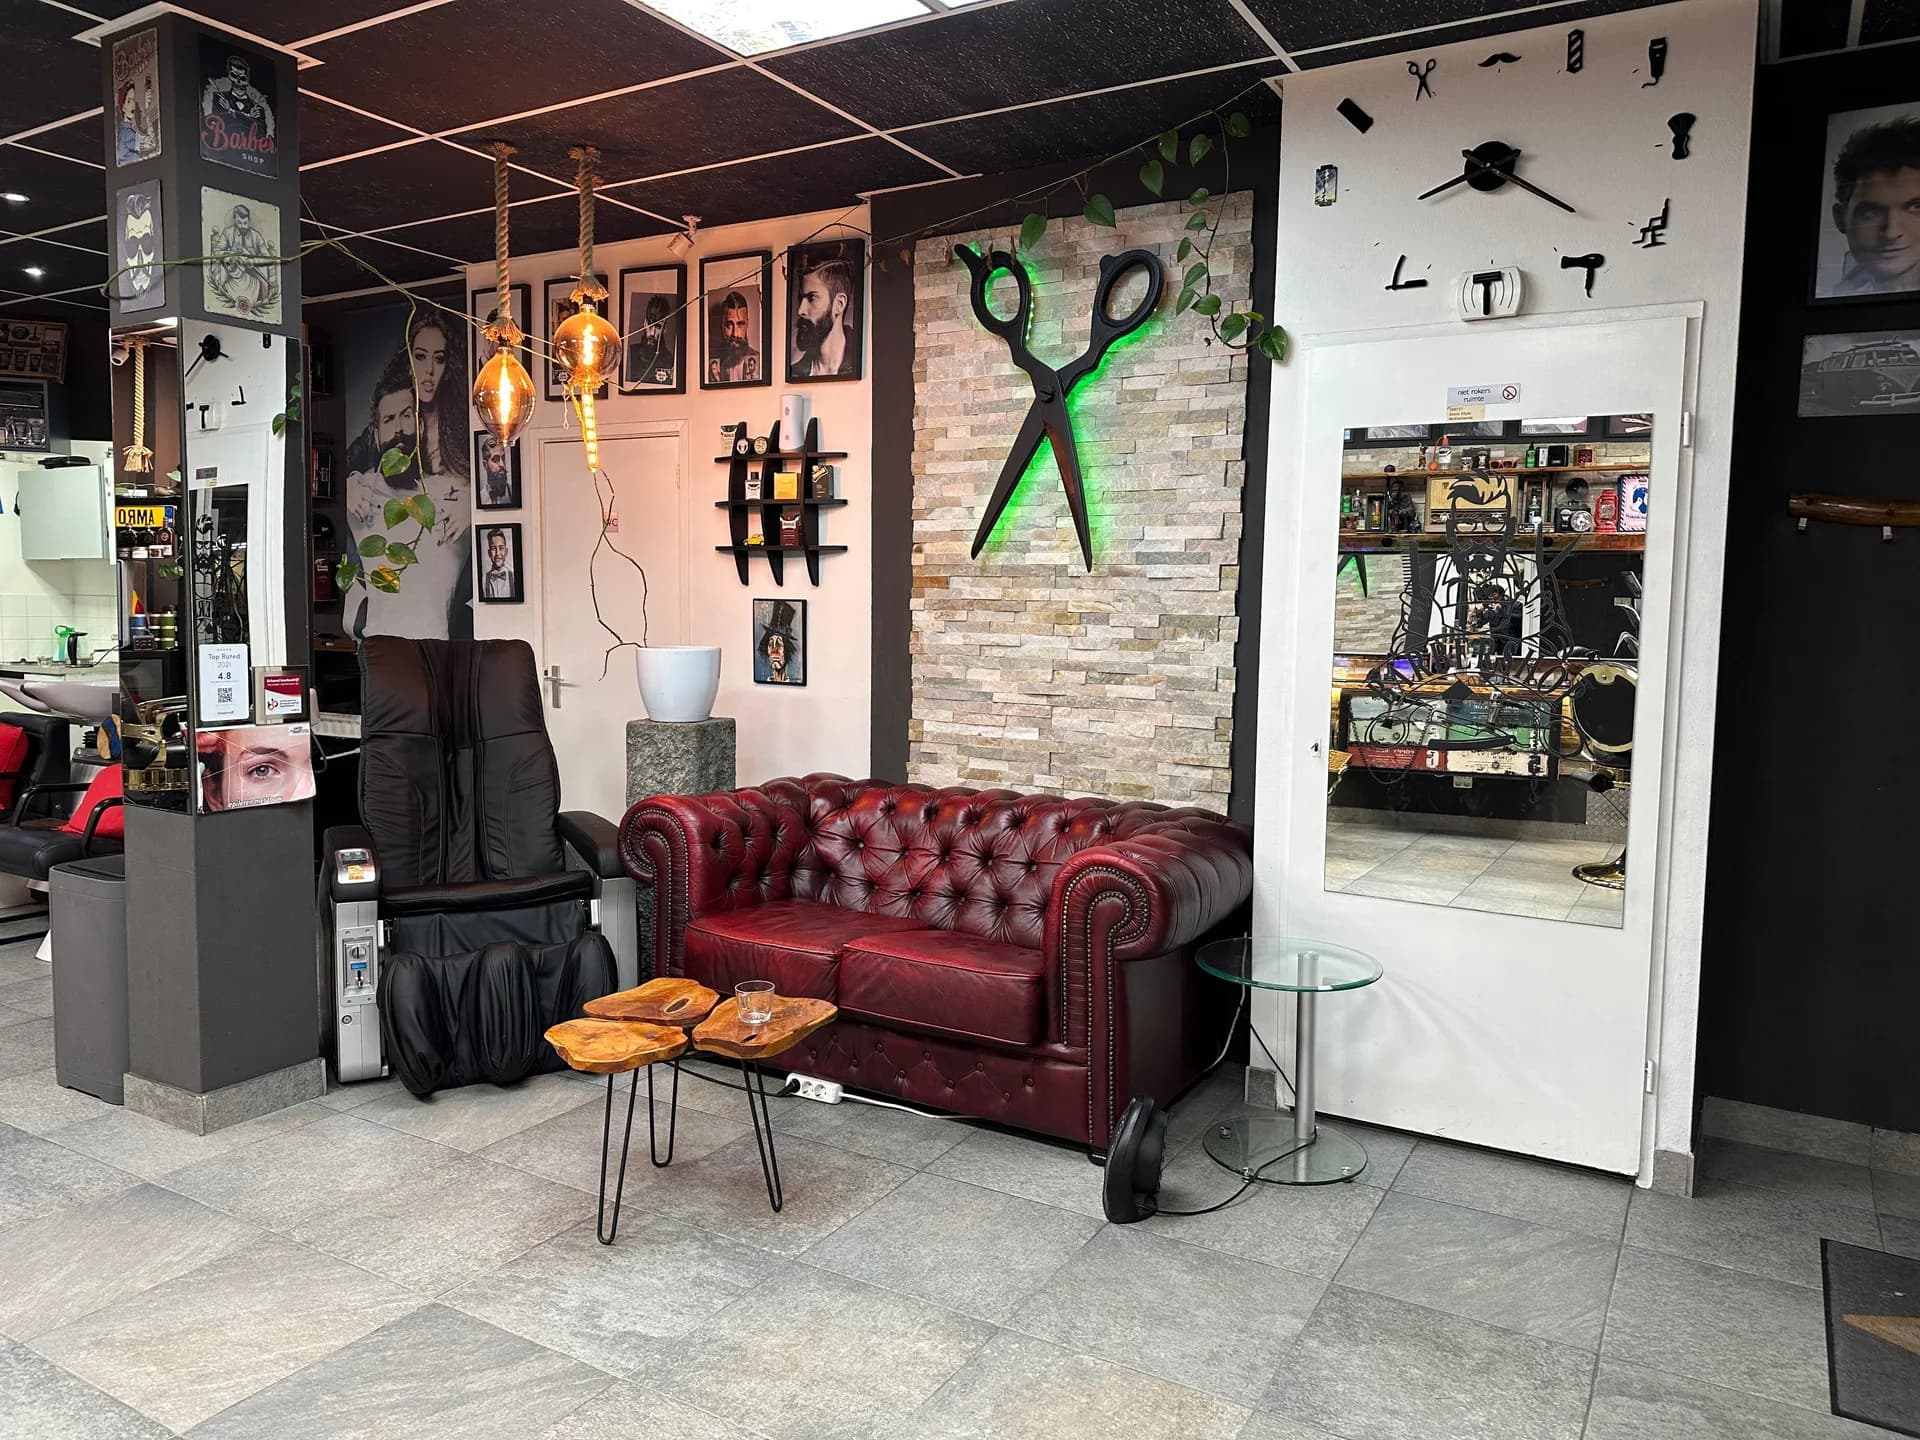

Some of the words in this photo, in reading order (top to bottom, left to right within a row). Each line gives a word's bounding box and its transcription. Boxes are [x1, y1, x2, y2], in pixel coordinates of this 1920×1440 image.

[201, 114, 277, 154] Barber
[242, 152, 265, 165] SHOP
[208, 653, 220, 661] Top
[217, 671, 232, 680] 4.8
